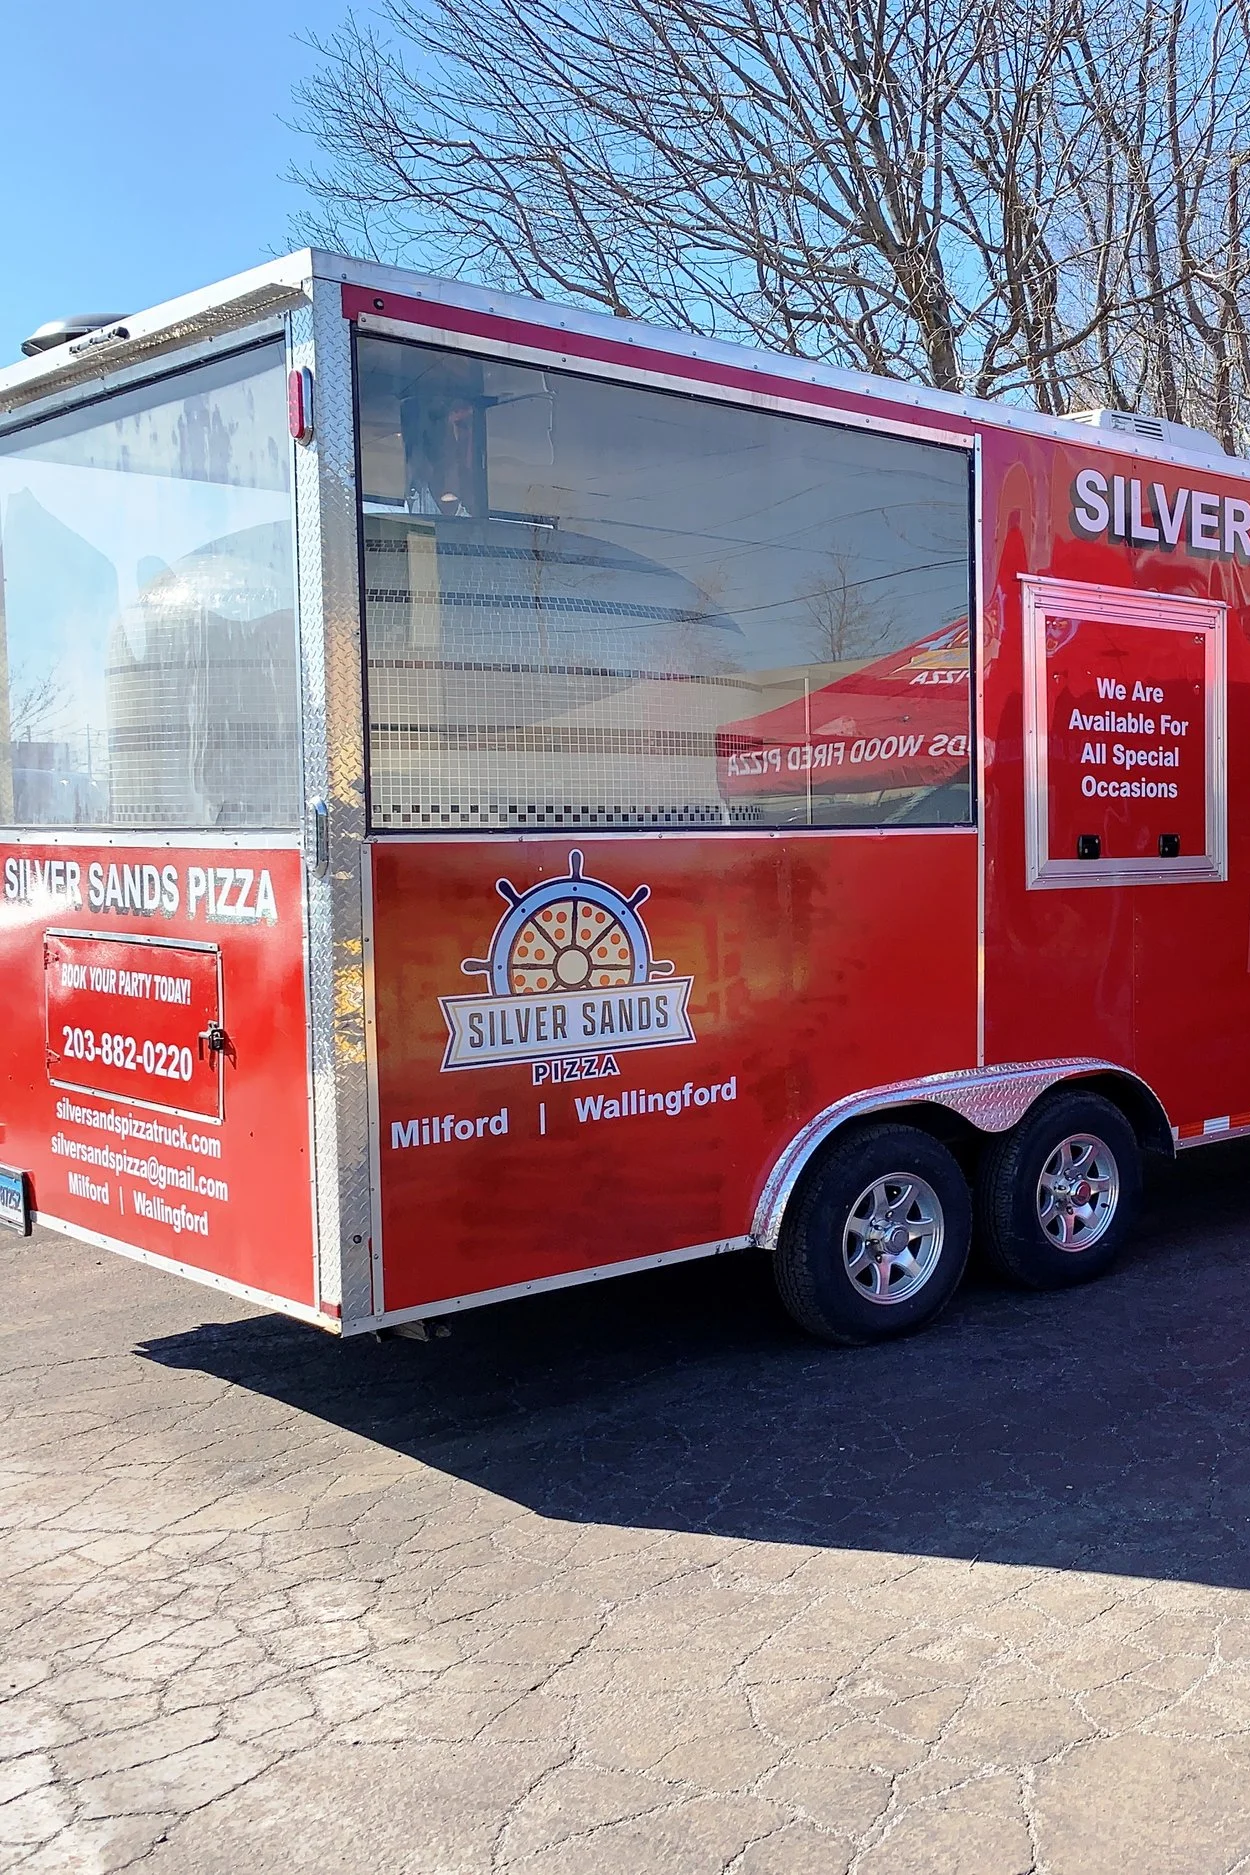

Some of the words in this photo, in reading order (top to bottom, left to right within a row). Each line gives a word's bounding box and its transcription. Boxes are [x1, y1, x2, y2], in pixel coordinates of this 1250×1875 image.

[1096, 677, 1126, 700] We
[1132, 681, 1164, 703] Are
[1068, 708, 1156, 735] Available
[1160, 714, 1190, 736] For
[1081, 742, 1107, 765] All
[1112, 743, 1180, 771] Special
[1081, 775, 1178, 798] Occasions
[4, 857, 83, 906] SILVER
[88, 861, 180, 914] SANDS
[187, 866, 279, 921] PIZZA
[61, 963, 88, 990] BOOK
[89, 967, 117, 994] YOUR
[118, 970, 152, 999] PARTY
[154, 974, 192, 1006] TODAY!
[468, 1003, 569, 1048] SILVER
[582, 995, 670, 1036] SANDS
[61, 1025, 193, 1082] 203-882-0220
[532, 1055, 621, 1086] PIZZA
[55, 1097, 222, 1160] silversandspizzatruck.com
[391, 1108, 509, 1150] Milford
[573, 1076, 738, 1122] Wallingford
[50, 1132, 229, 1202] silversandspizza@gmail.com
[68, 1171, 110, 1206] Milford
[132, 1190, 209, 1237] Wallingford
